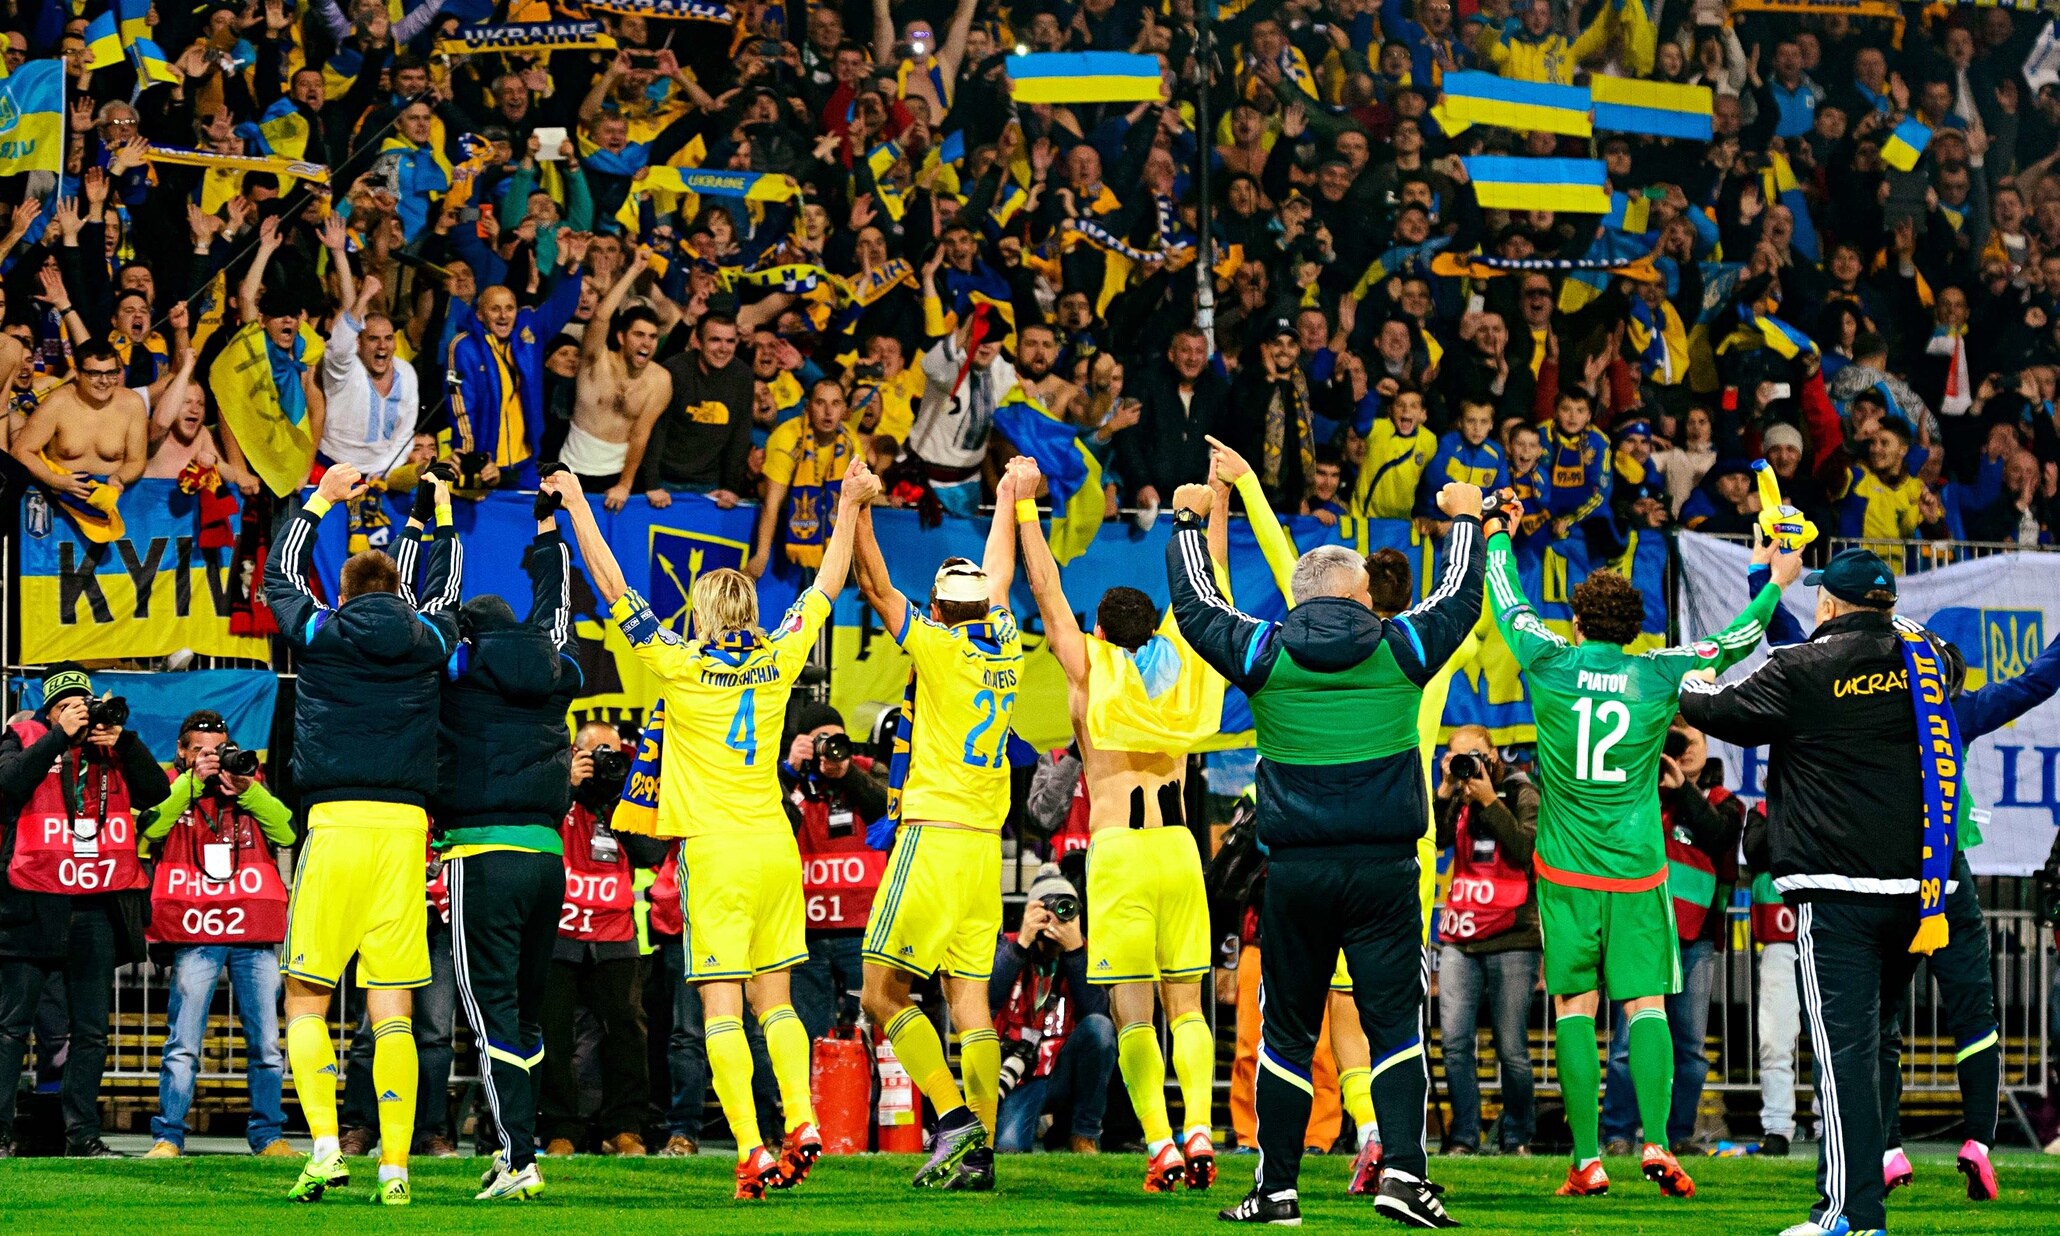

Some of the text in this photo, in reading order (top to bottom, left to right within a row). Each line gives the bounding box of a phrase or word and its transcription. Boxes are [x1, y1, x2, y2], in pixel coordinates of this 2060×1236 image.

[464, 23, 598, 48] UKRAINE
[687, 174, 746, 190] UKRAINE
[58, 536, 239, 626] KYIV
[49, 674, 88, 693] ELAN
[1577, 669, 1628, 693] PIATOV
[725, 687, 758, 766] 4
[1570, 697, 1630, 782] 12
[44, 817, 127, 844] PHTO
[58, 858, 117, 890] 067
[565, 867, 619, 902] OTO
[802, 857, 865, 885] HOTO
[1450, 877, 1495, 905] OTO
[182, 907, 245, 936] 062
[558, 902, 594, 933] 21
[807, 895, 844, 922] 61
[386, 1193, 409, 1201] adidas
